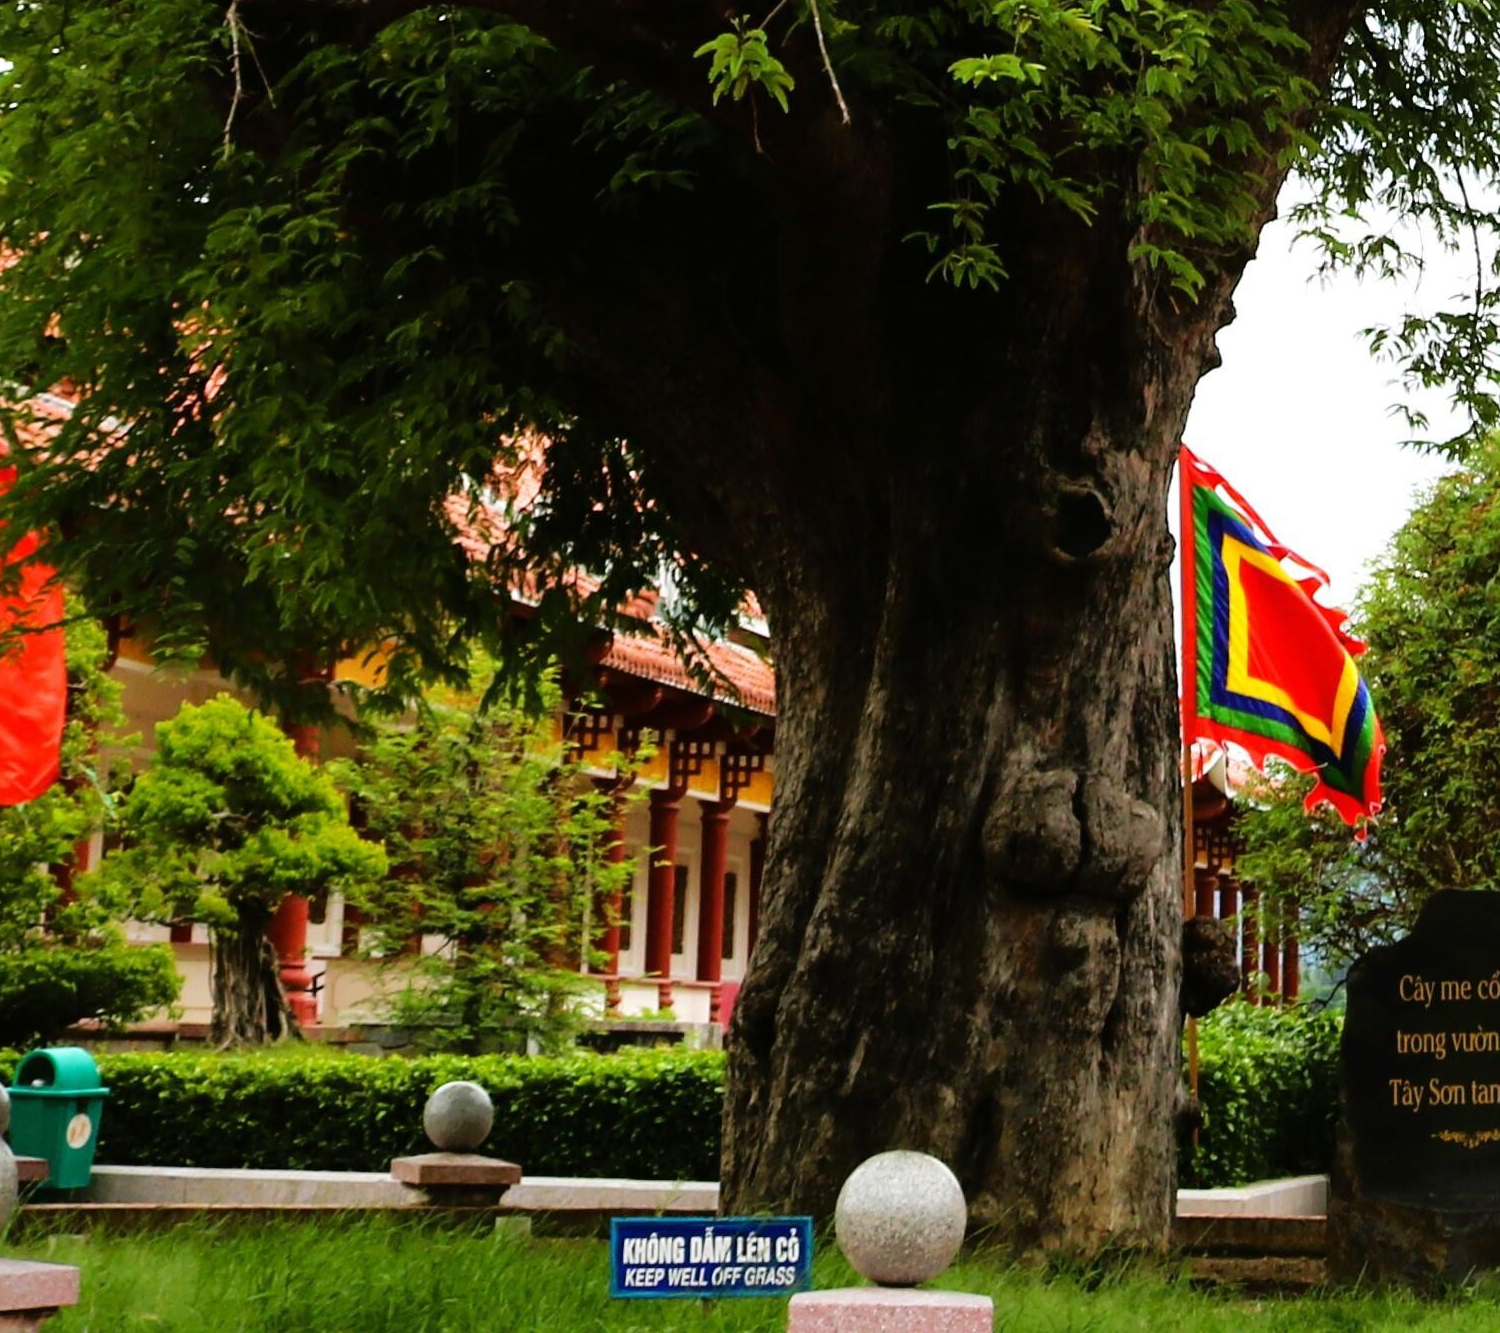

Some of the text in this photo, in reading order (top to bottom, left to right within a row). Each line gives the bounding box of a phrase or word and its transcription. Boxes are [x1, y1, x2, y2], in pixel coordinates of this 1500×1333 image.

[1400, 974, 1435, 1008] Cây
[1441, 981, 1472, 1001] me
[1477, 970, 1500, 1000] cổ
[1397, 1030, 1446, 1060] trong
[1452, 1025, 1500, 1052] vườn
[1389, 1079, 1424, 1113] Tây
[1429, 1078, 1465, 1105] Sơn
[623, 1232, 684, 1265] KHÔNG
[776, 1228, 799, 1262] CỎ
[625, 1267, 795, 1287] KEEP WELL OFF GRASS
